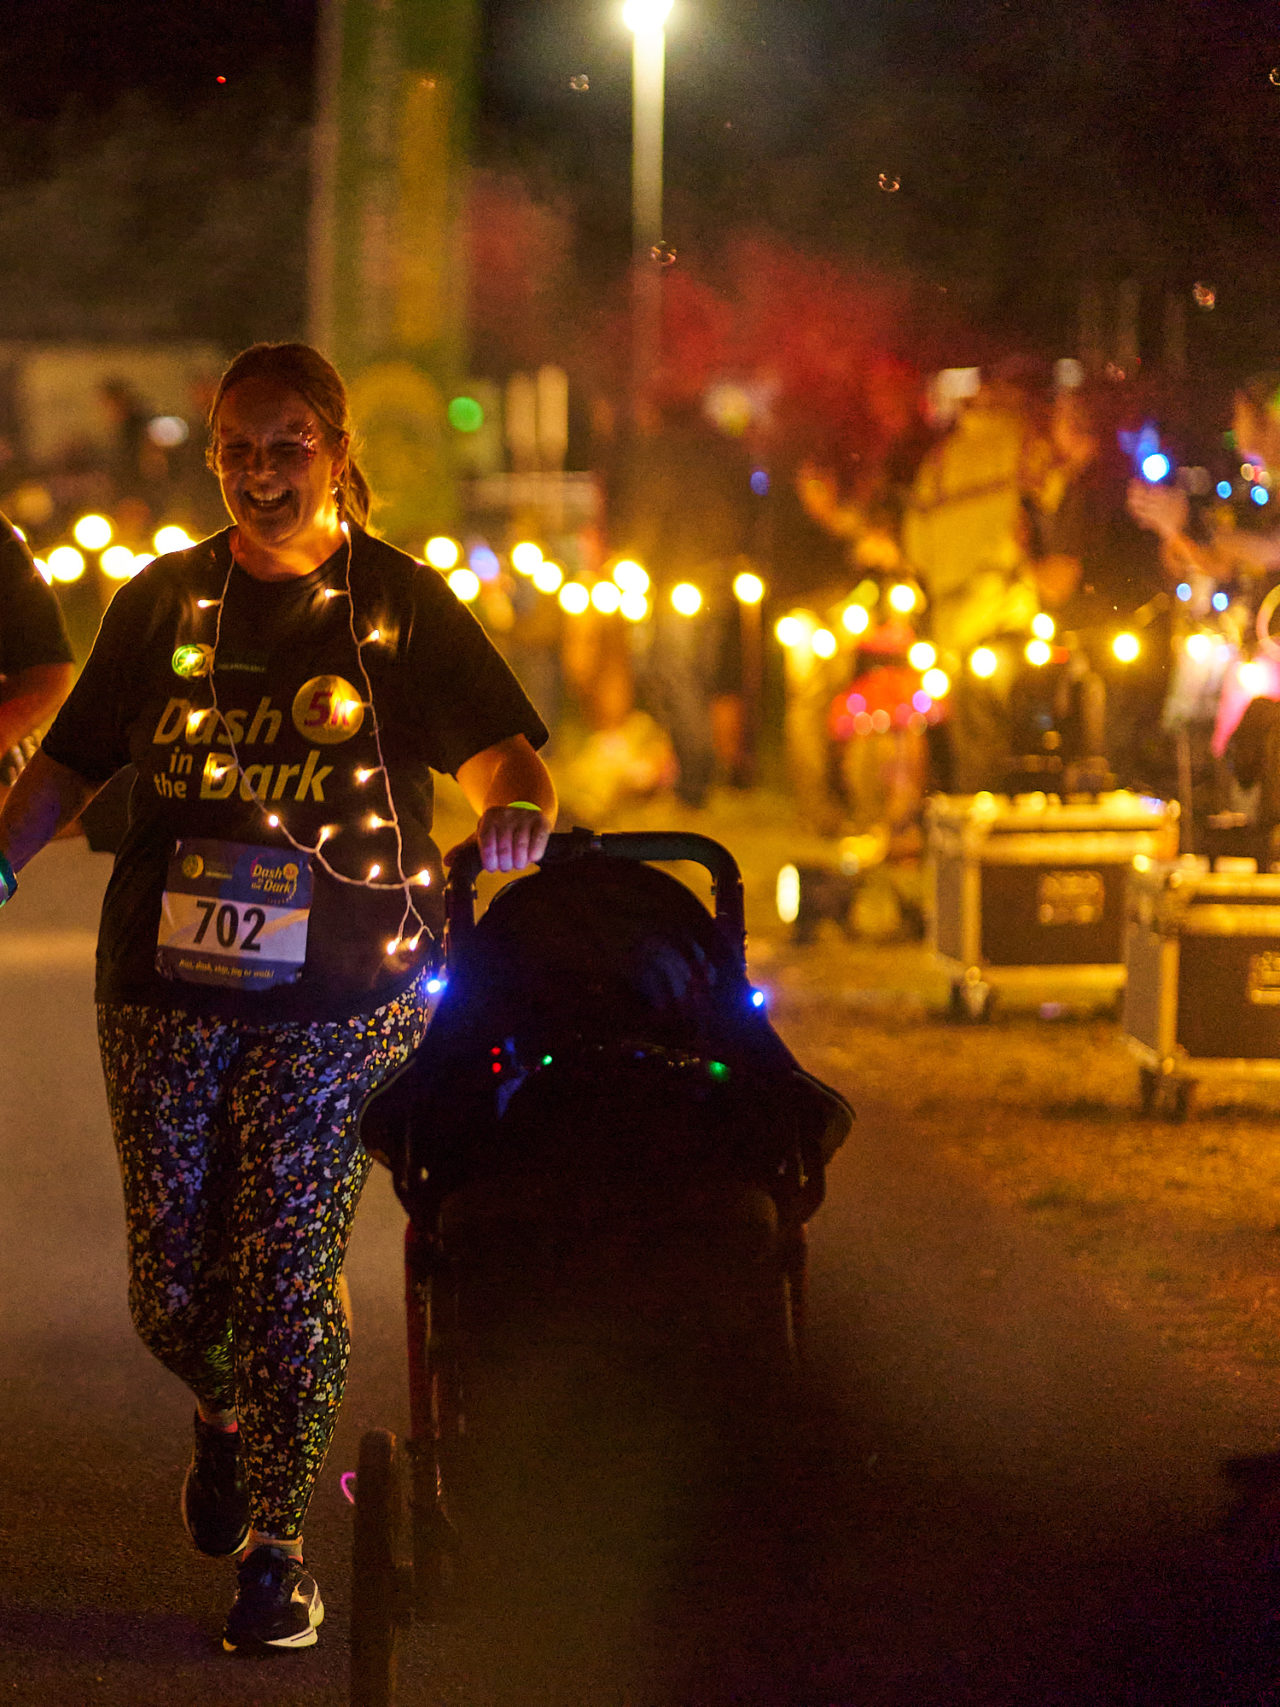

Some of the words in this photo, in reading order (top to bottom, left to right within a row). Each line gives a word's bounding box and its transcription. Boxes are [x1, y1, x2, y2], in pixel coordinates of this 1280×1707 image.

[153, 696, 283, 744] Dash
[304, 691, 351, 728] 5K
[153, 773, 187, 799] the
[200, 750, 334, 801] Dark
[170, 746, 194, 773] in
[252, 864, 283, 880] Dash
[264, 879, 292, 894] Dark
[192, 901, 267, 952] 702
